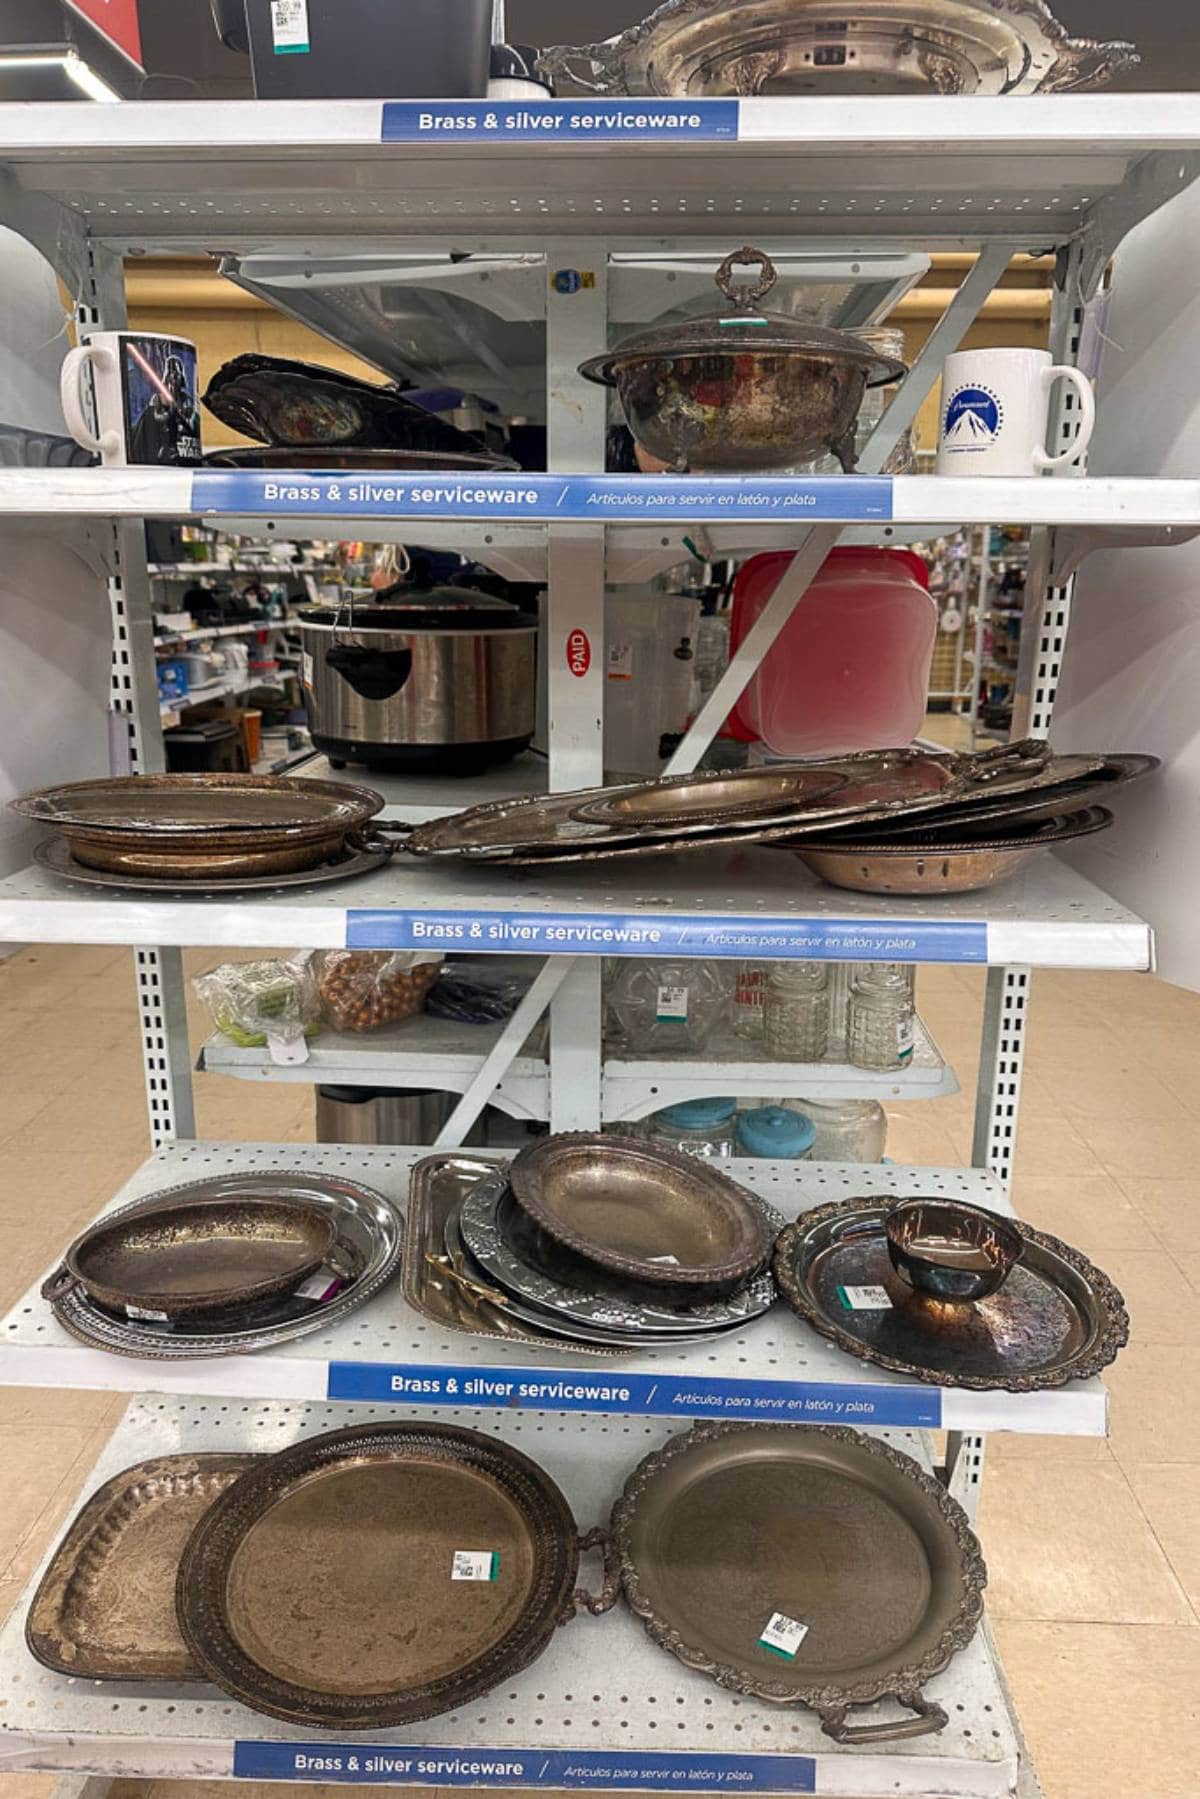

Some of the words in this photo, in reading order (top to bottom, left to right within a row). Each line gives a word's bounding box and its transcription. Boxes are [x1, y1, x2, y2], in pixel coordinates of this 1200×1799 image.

[419, 113, 476, 129] Brass
[483, 113, 498, 129] &
[505, 112, 563, 129] silver
[570, 112, 700, 128] serviceware
[264, 484, 320, 500] Brass
[327, 484, 341, 500] &
[349, 485, 404, 501] silver
[411, 486, 538, 504] serviceware
[646, 495, 675, 506] para
[679, 493, 715, 505] servir
[718, 495, 734, 505] en
[738, 492, 769, 505] latón
[771, 496, 781, 507] y
[784, 493, 816, 507] plata
[571, 634, 586, 672] PAID
[413, 922, 463, 937] Brass
[470, 922, 482, 938] &
[488, 923, 540, 939] silver
[545, 925, 661, 942] serviceware
[760, 935, 785, 947] para
[789, 936, 822, 946] servir
[825, 938, 840, 947] en
[843, 937, 872, 948] latón
[875, 939, 885, 951] y
[886, 938, 916, 950] plata
[391, 1375, 440, 1392] Brass
[446, 1378, 458, 1393] &
[464, 1379, 513, 1396] silver
[520, 1382, 629, 1400] serviceware
[725, 1396, 751, 1407] para
[754, 1397, 786, 1408] servir
[787, 1399, 802, 1409] en
[805, 1399, 833, 1410] latón
[835, 1402, 844, 1413] y
[845, 1401, 874, 1413] plata
[295, 1754, 342, 1770] Brass
[347, 1756, 359, 1771] &
[365, 1756, 412, 1772] silver
[418, 1758, 523, 1775] serviceware
[613, 1769, 638, 1779] para
[640, 1768, 670, 1779] servir
[672, 1770, 686, 1779] en
[688, 1769, 715, 1780] latón
[717, 1772, 724, 1782] y
[726, 1770, 753, 1781] plata
